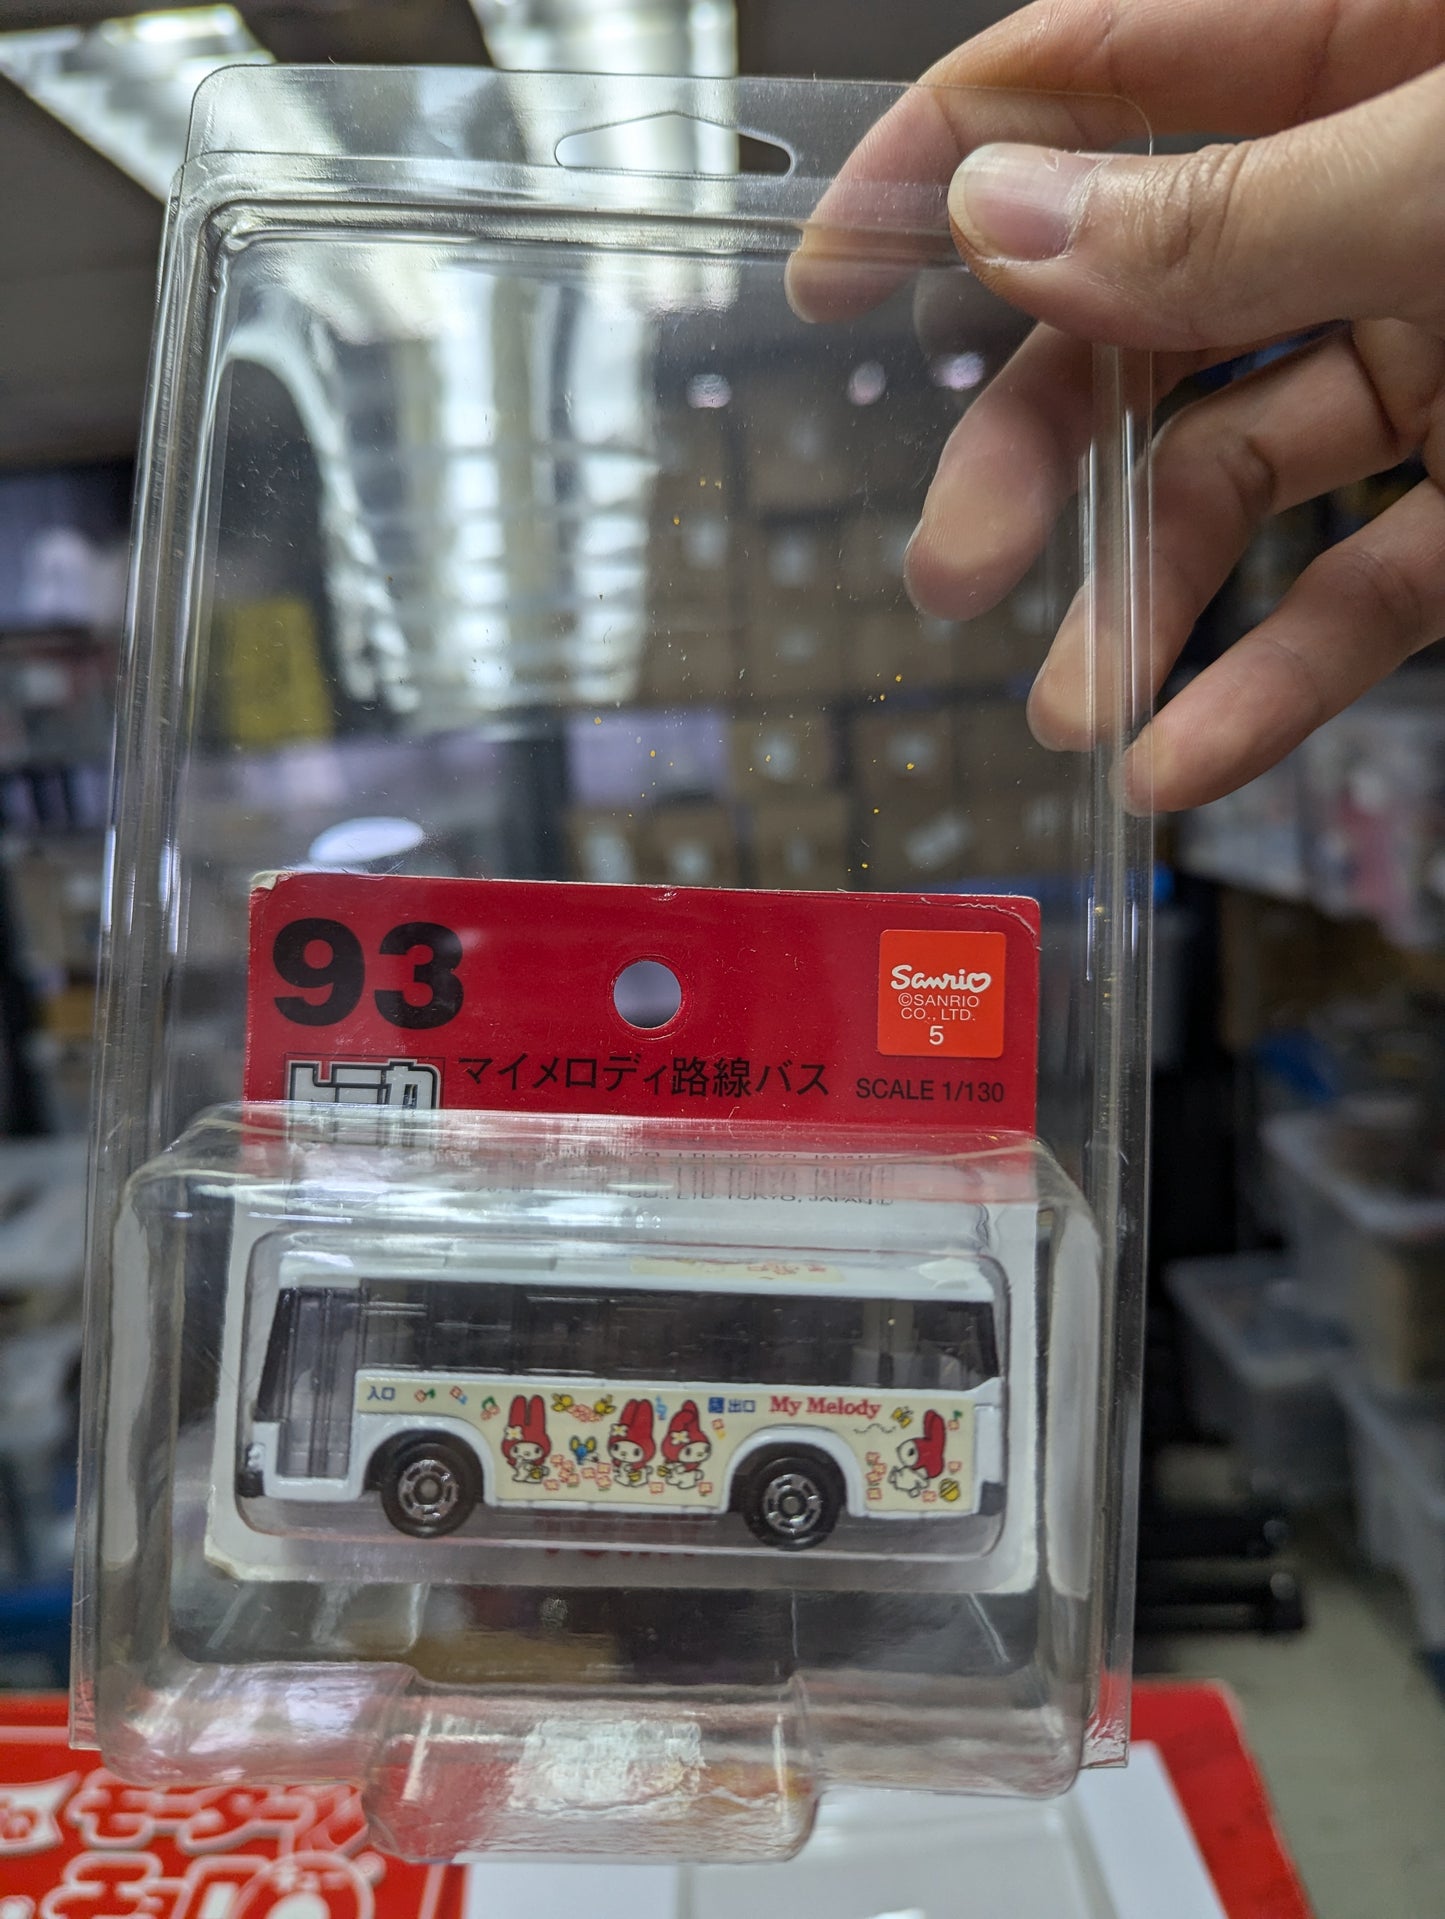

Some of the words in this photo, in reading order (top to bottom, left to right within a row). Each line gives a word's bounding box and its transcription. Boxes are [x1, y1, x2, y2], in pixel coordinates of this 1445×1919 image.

[273, 917, 465, 1030] 93
[890, 964, 992, 993] Sanrio
[901, 1007, 937, 1021] CO.,
[941, 1008, 976, 1021] LTD.
[928, 1025, 945, 1046] 5
[458, 1051, 830, 1099] マイメロディ路線バス
[855, 1077, 935, 1101] SCALE
[942, 1080, 1006, 1103] 1/130
[366, 1385, 396, 1401] 入口
[728, 1398, 756, 1413] 出口
[768, 1395, 803, 1417] My
[806, 1396, 882, 1420] Melody
